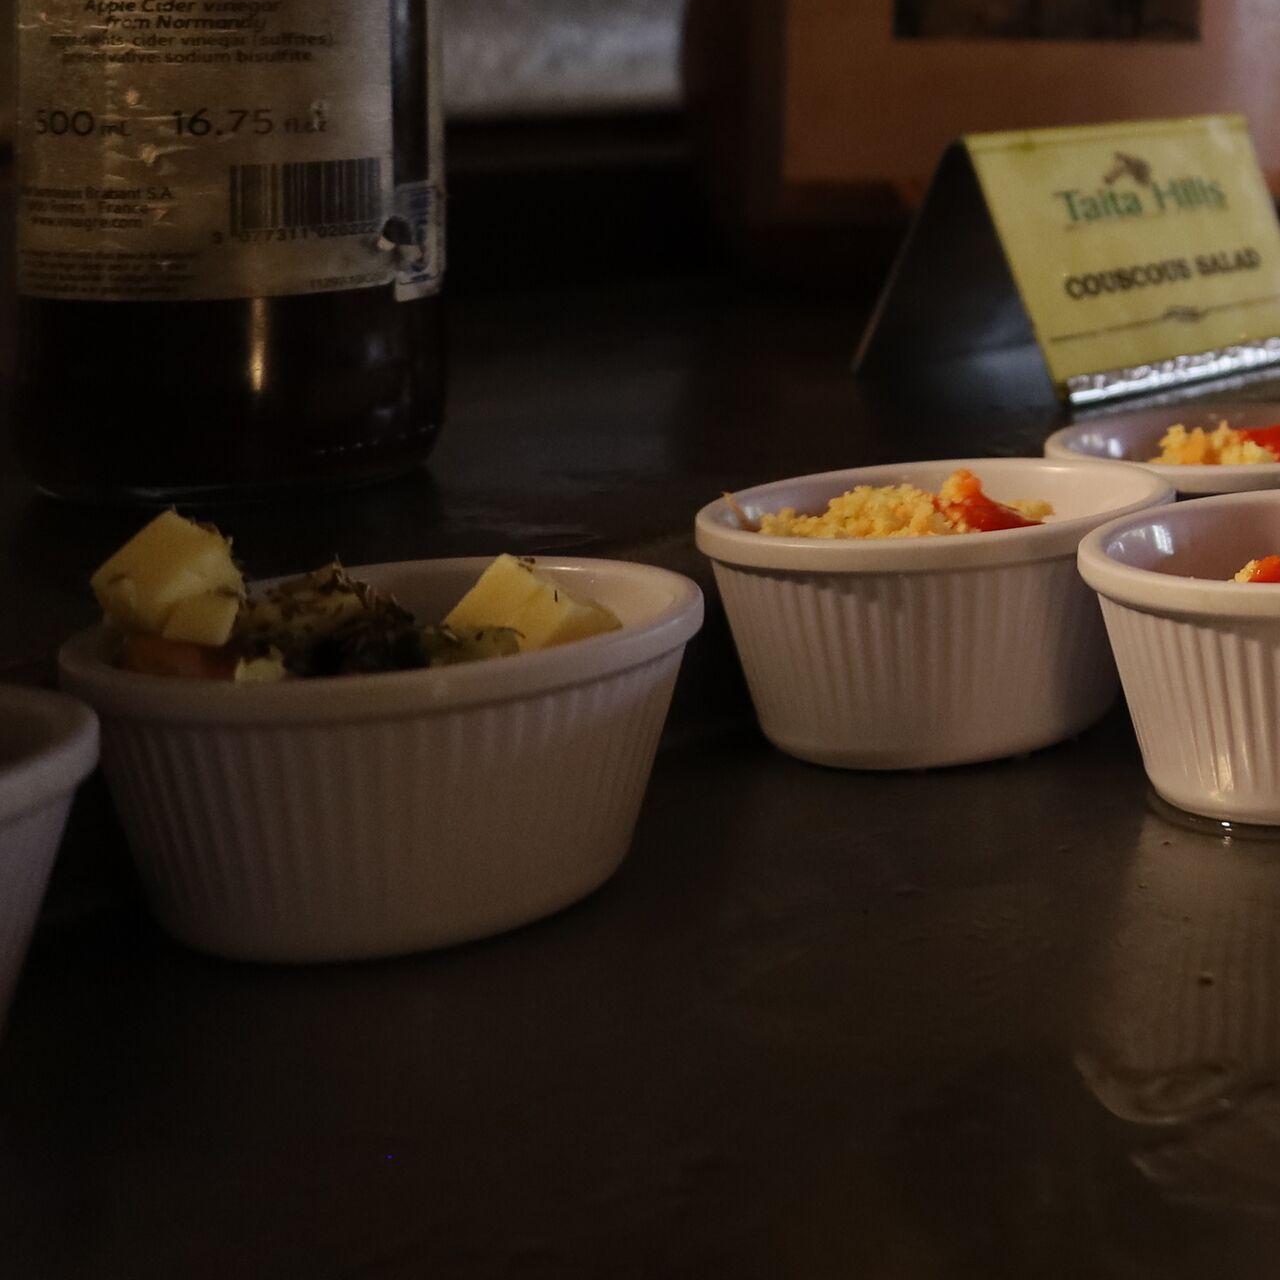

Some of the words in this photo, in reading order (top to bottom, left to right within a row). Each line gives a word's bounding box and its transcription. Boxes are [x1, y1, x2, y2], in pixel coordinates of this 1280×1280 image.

[204, 1, 282, 16] vinegar
[104, 16, 150, 33] from
[156, 15, 266, 32] Normandy
[164, 51, 231, 63] sodium
[36, 110, 94, 136] 500
[172, 108, 273, 136] 16.75
[99, 201, 149, 214] France
[1055, 189, 1142, 223] Taita
[1152, 176, 1228, 212] Hills
[212, 231, 223, 245] 3
[1065, 258, 1191, 300] COUSCOUS
[1196, 247, 1261, 276] SALAD
